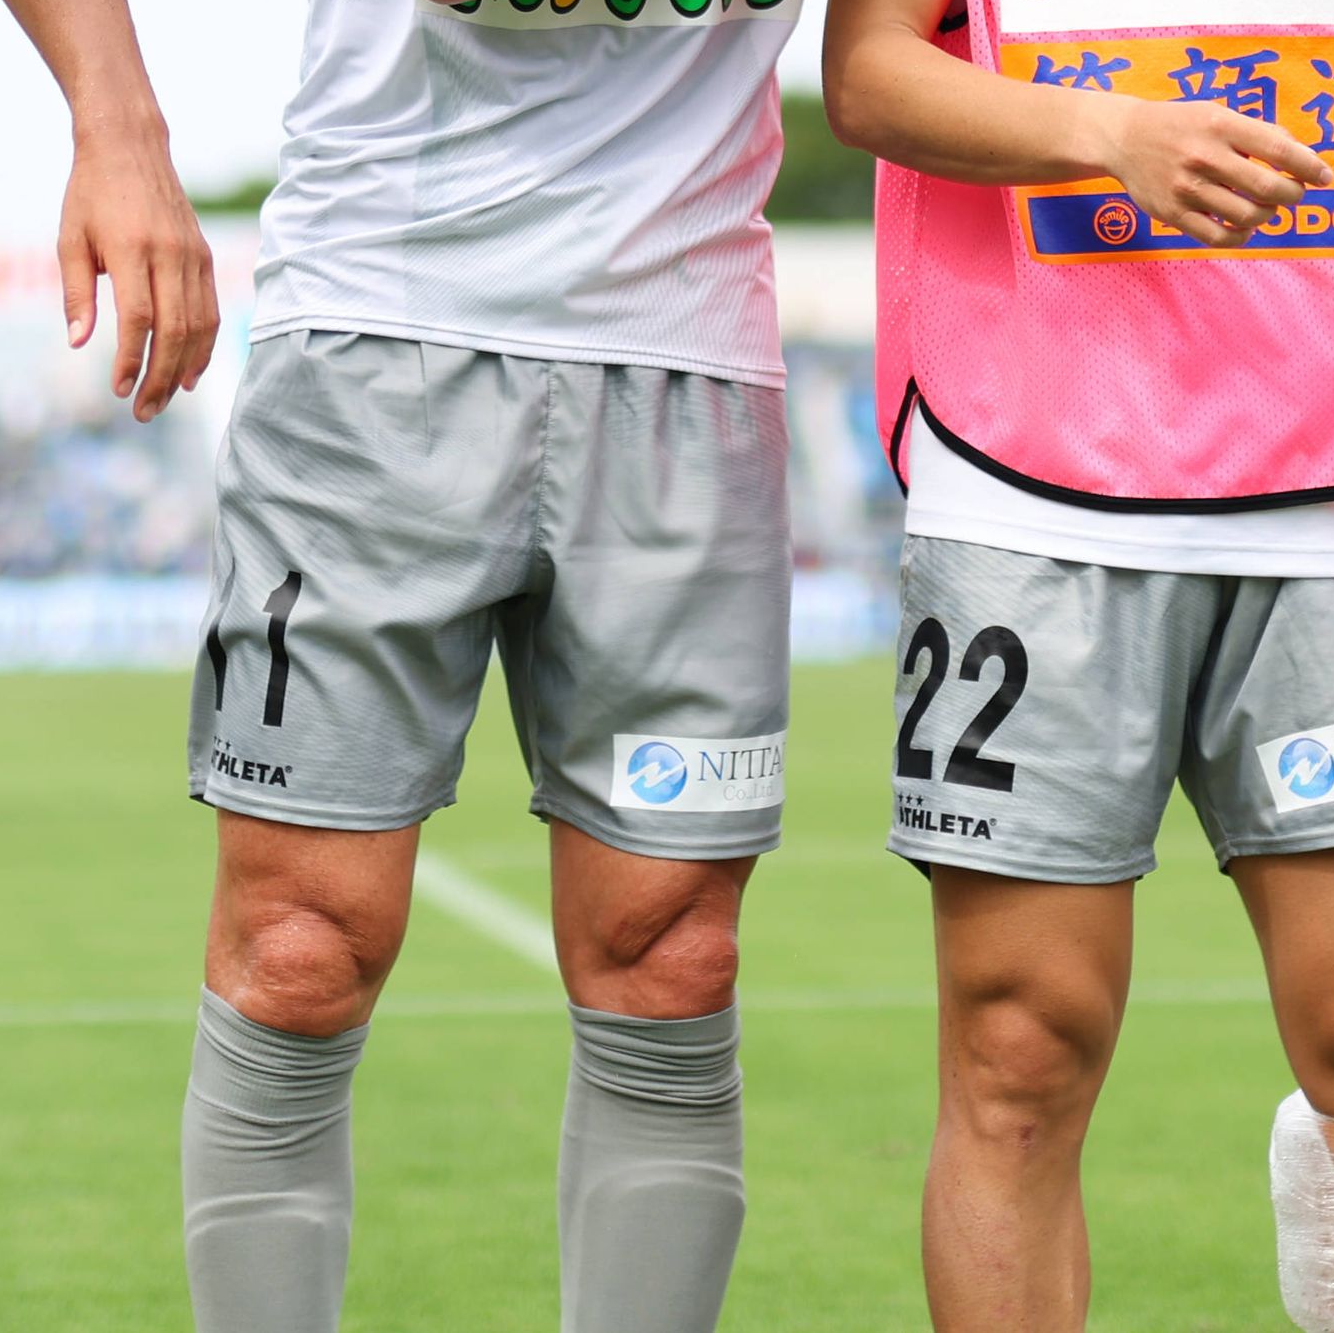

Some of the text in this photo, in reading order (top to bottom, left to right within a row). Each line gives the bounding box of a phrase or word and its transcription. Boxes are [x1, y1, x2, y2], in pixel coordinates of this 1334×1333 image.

[1100, 208, 1130, 225] smile
[896, 617, 1029, 792] 22
[698, 742, 786, 781] NITTA
